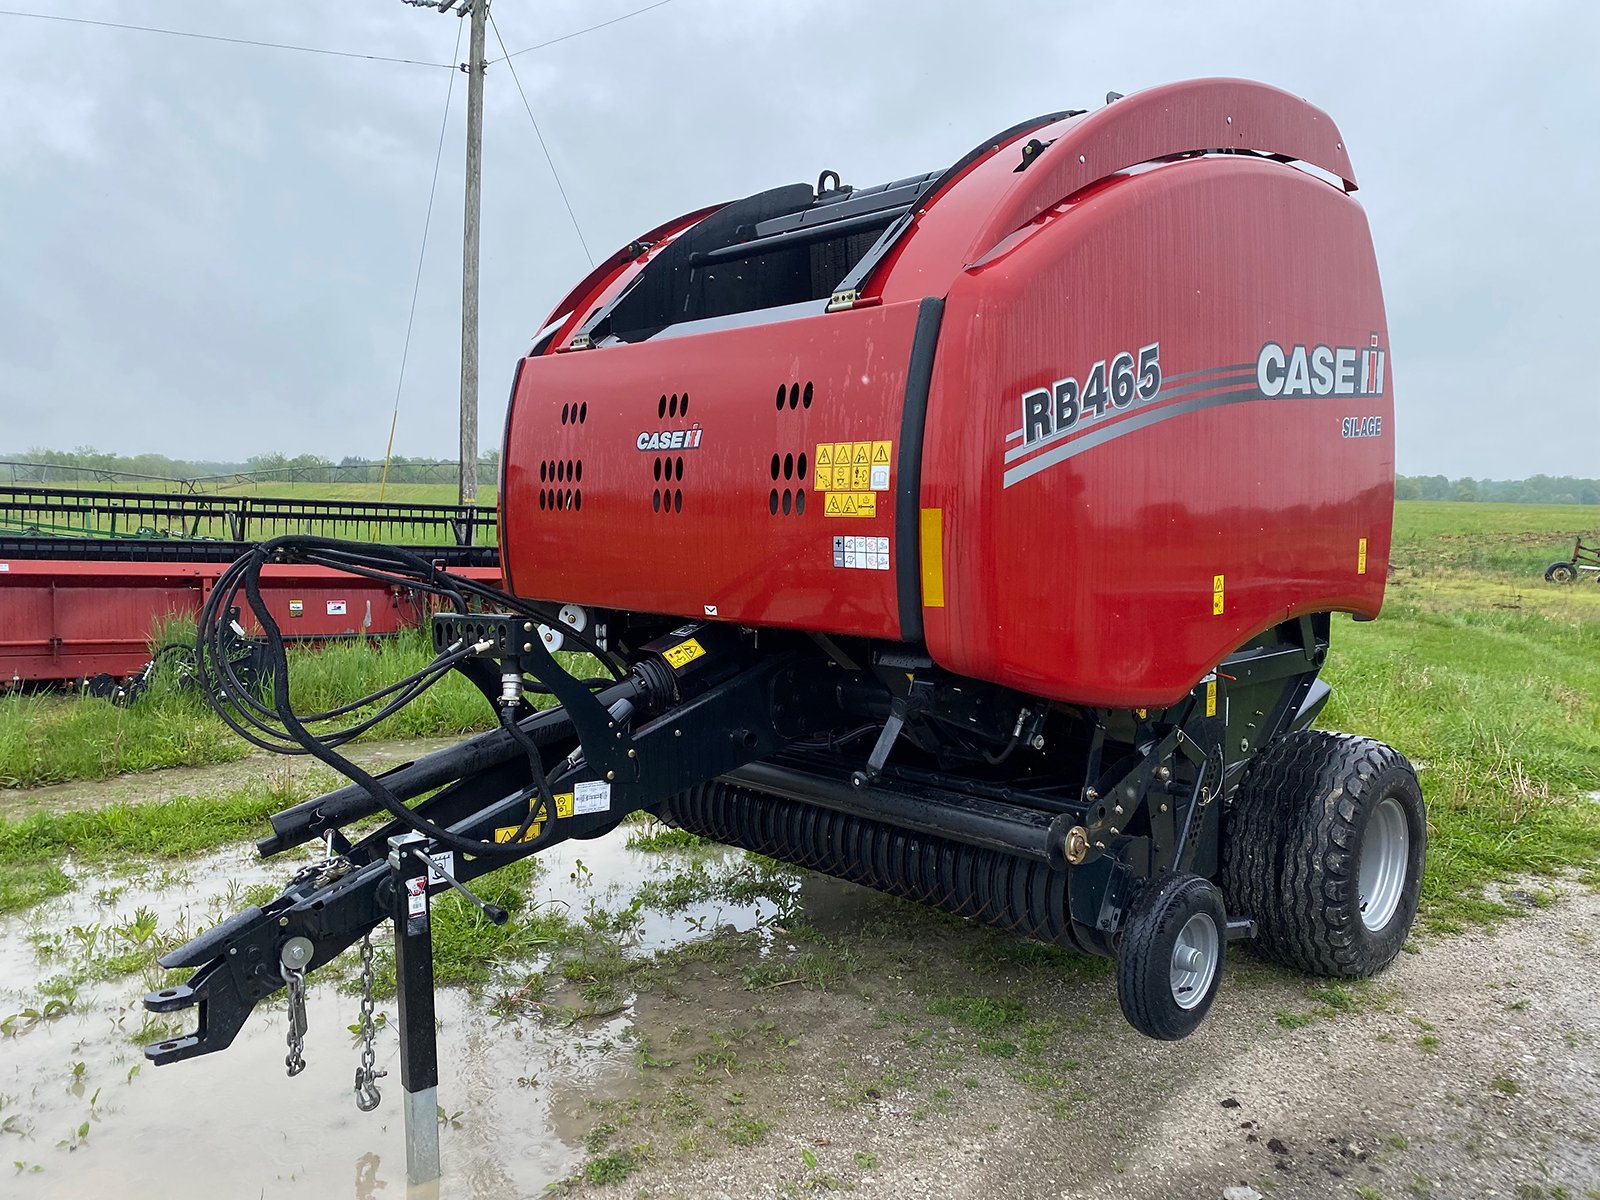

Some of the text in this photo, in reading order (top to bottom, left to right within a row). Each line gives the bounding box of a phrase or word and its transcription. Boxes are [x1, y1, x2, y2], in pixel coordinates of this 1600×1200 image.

[1257, 343, 1356, 396] CASE
[1022, 342, 1162, 448] RB465
[636, 431, 684, 450] CASE
[1341, 416, 1382, 438] SILAGE
